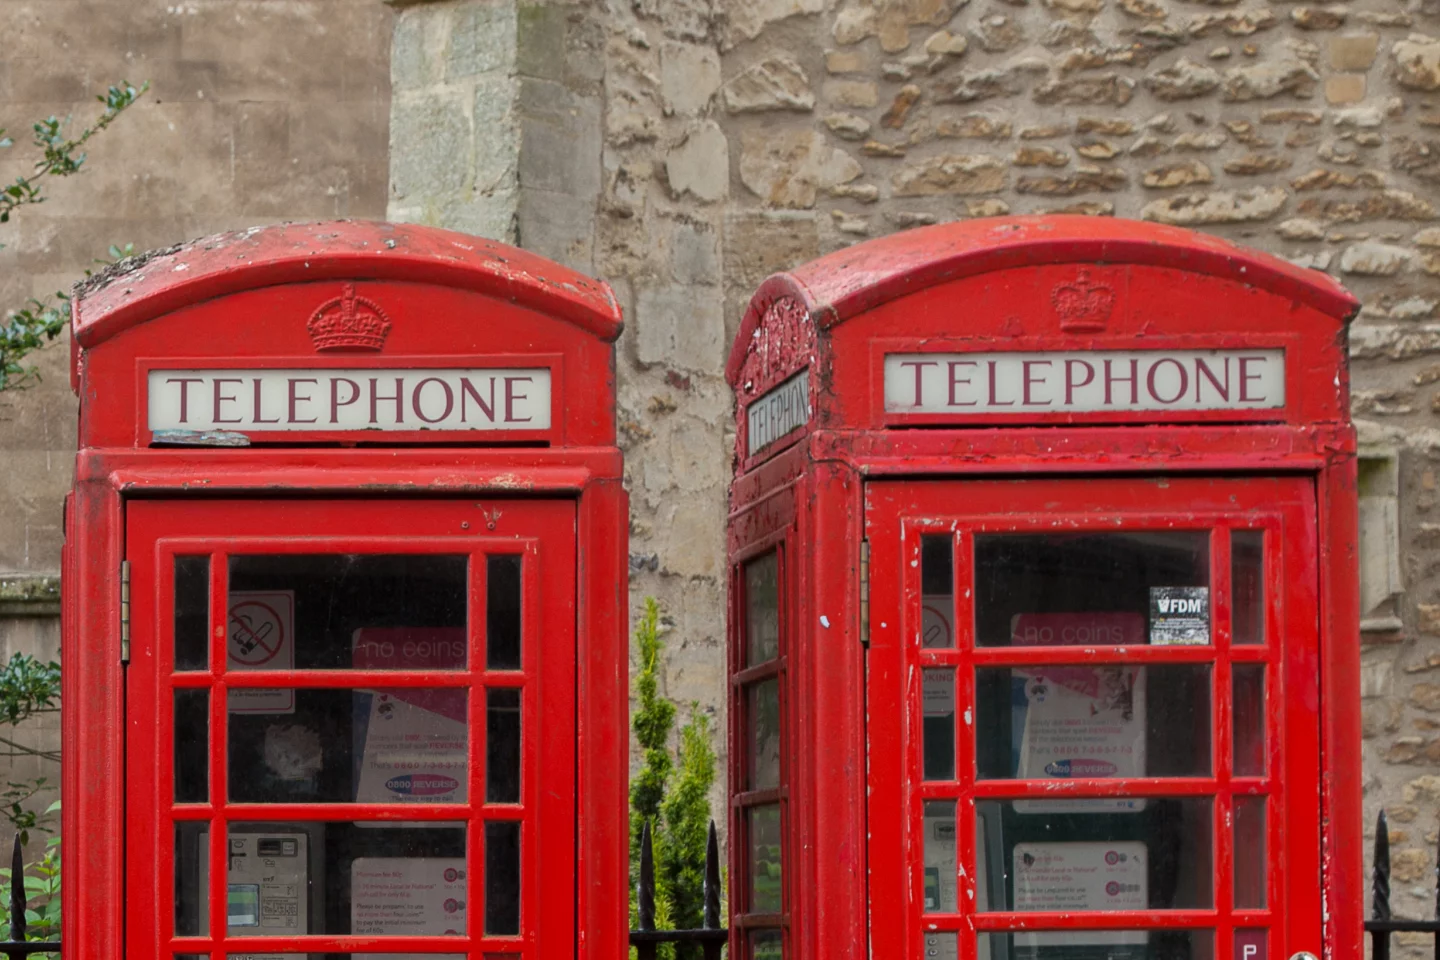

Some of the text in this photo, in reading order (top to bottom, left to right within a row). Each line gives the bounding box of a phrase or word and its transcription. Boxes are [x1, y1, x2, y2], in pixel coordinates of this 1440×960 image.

[900, 356, 1268, 406] TELEPHONE
[165, 376, 534, 424] TELEPHONE
[751, 375, 809, 447] TELEPHON
[366, 641, 394, 658] no
[1025, 622, 1124, 643] no coins
[387, 780, 411, 789] 0800
